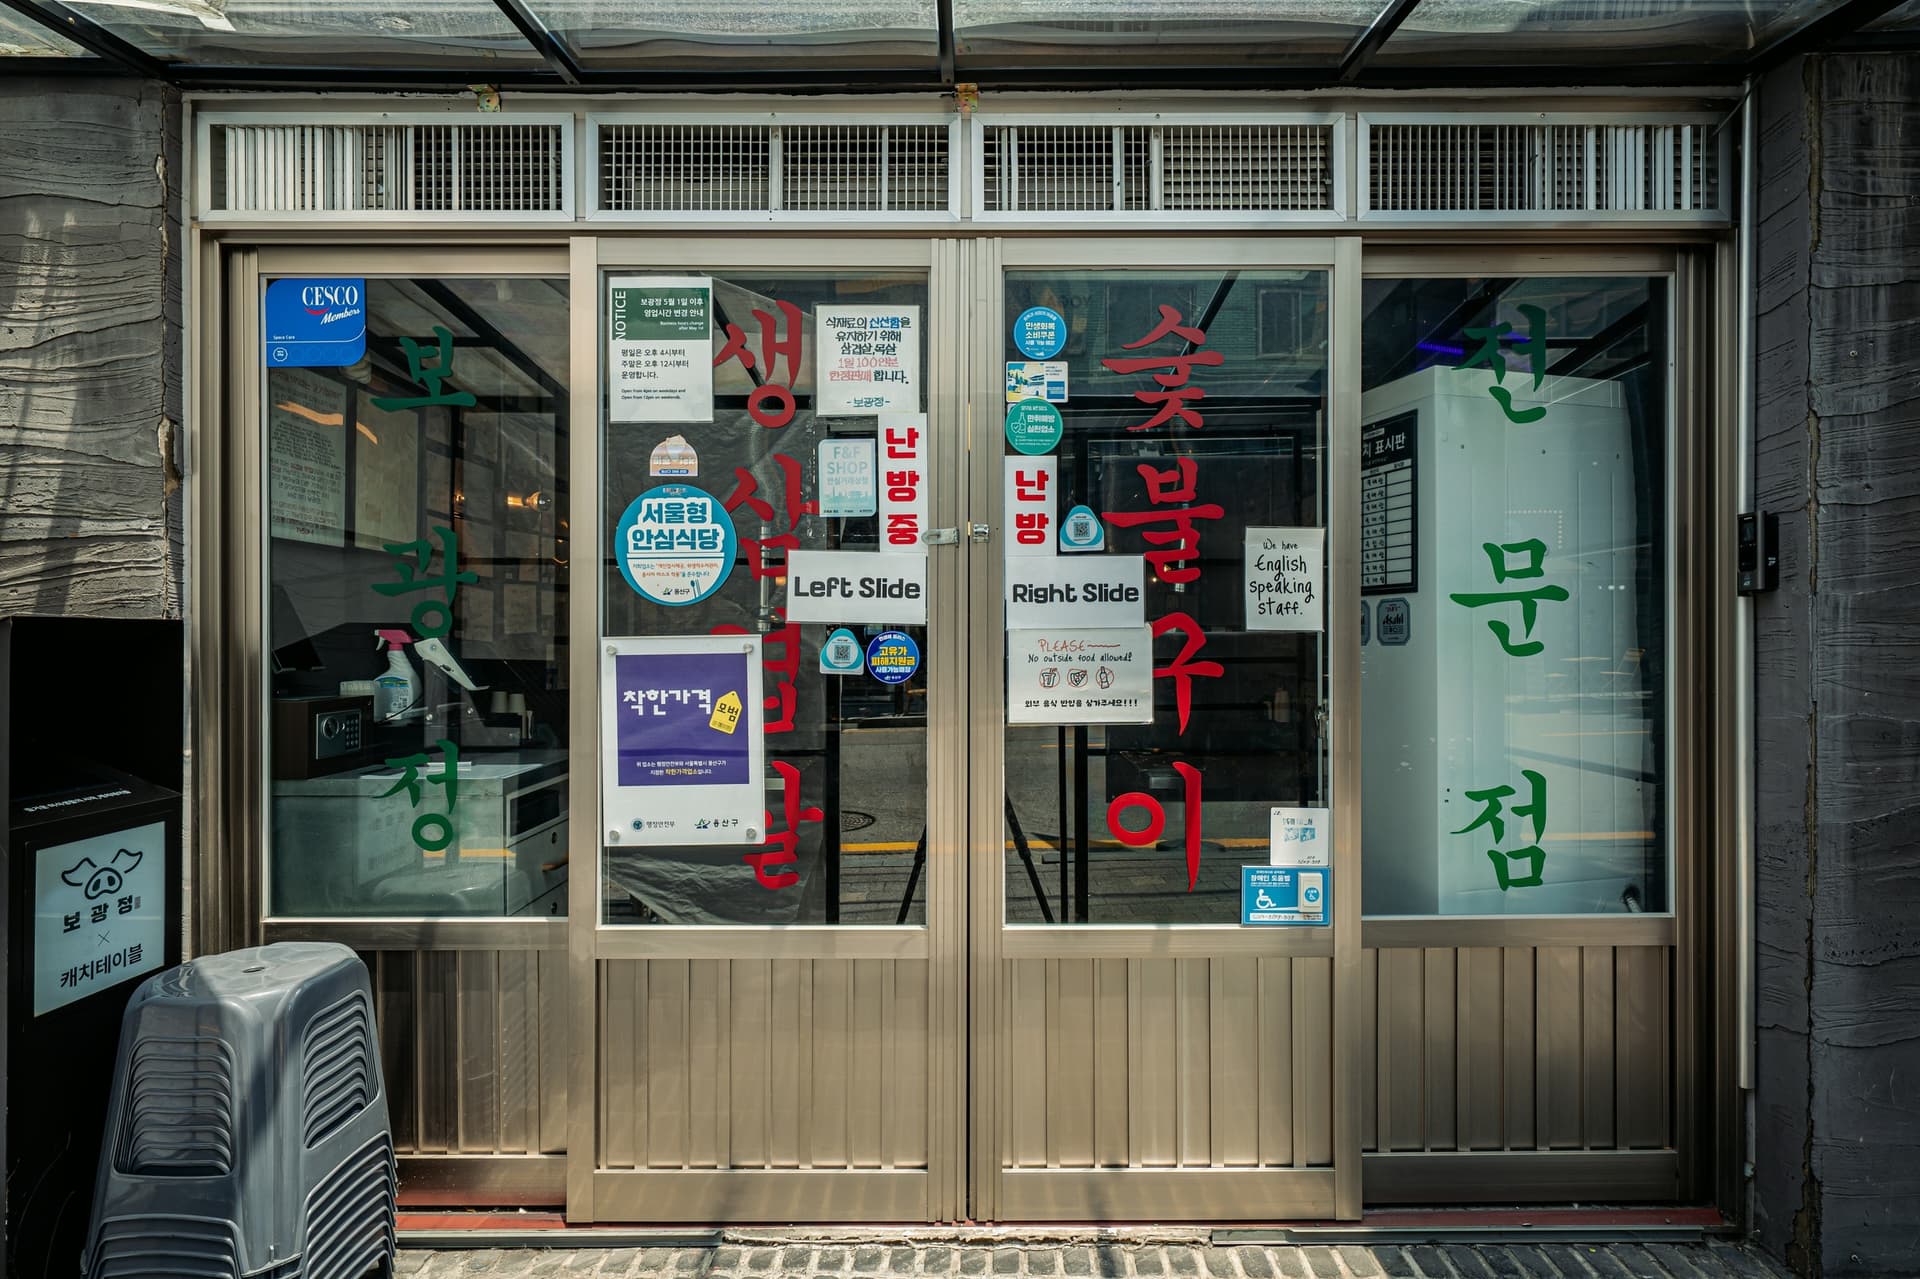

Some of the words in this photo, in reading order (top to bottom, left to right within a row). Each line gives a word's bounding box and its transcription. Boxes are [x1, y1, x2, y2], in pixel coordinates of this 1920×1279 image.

[302, 285, 358, 306] CESCO
[640, 297, 662, 306] 보광정
[663, 298, 675, 306] 5월
[677, 298, 688, 306] 1일
[689, 297, 704, 306] 이후
[320, 307, 360, 325] Members
[615, 290, 627, 341] NOTICE
[643, 309, 672, 318] 영업시간
[673, 309, 688, 318] 변경
[689, 309, 704, 318] 안내
[825, 316, 868, 329] 식재료의
[869, 316, 911, 329] 신선함을
[1025, 322, 1056, 330] 민생회복
[1025, 331, 1056, 339] 소비쿠폰
[835, 330, 878, 342] 유지하기
[879, 330, 902, 343] 위해
[621, 348, 642, 357] 평일은
[644, 348, 658, 357] 오후
[660, 348, 685, 357] 4시부터
[621, 360, 642, 368] 주말은
[644, 360, 658, 368] 오후
[660, 360, 689, 368] 12시부터
[838, 357, 855, 368] 1일
[1374, 431, 1406, 455] 표시판
[833, 446, 861, 460] F&F
[827, 462, 868, 474] SHOP
[885, 427, 920, 545] 난방중
[642, 502, 708, 524] 서울형
[1015, 470, 1049, 545] 난방
[632, 528, 720, 551] 안심식당
[1263, 538, 1276, 550] We
[1281, 540, 1298, 550] have
[1254, 554, 1307, 582] English
[370, 325, 480, 852] 보광정
[794, 576, 854, 597] Left
[858, 577, 920, 599] Slide
[1012, 584, 1077, 603] Right
[1082, 583, 1139, 603] Slide
[1249, 577, 1315, 604] speaking
[1101, 304, 1225, 892] 숯불구이
[1258, 597, 1303, 616] staff.
[1450, 303, 1570, 892] 전문점
[879, 646, 907, 656] 고유가
[1038, 639, 1086, 652] PLEASE
[871, 656, 915, 666] 피해지원금
[1028, 654, 1039, 663] No
[1043, 654, 1073, 662] outside
[1078, 653, 1096, 662] food
[623, 689, 711, 716] 착한가격
[1025, 700, 1040, 708] 외부
[1043, 700, 1058, 708] 음식
[1060, 700, 1083, 708] 반입을
[717, 703, 739, 722] 모범
[713, 819, 739, 827] 용산구
[63, 895, 133, 934] 보광정
[60, 943, 143, 987] 캐치테이블
